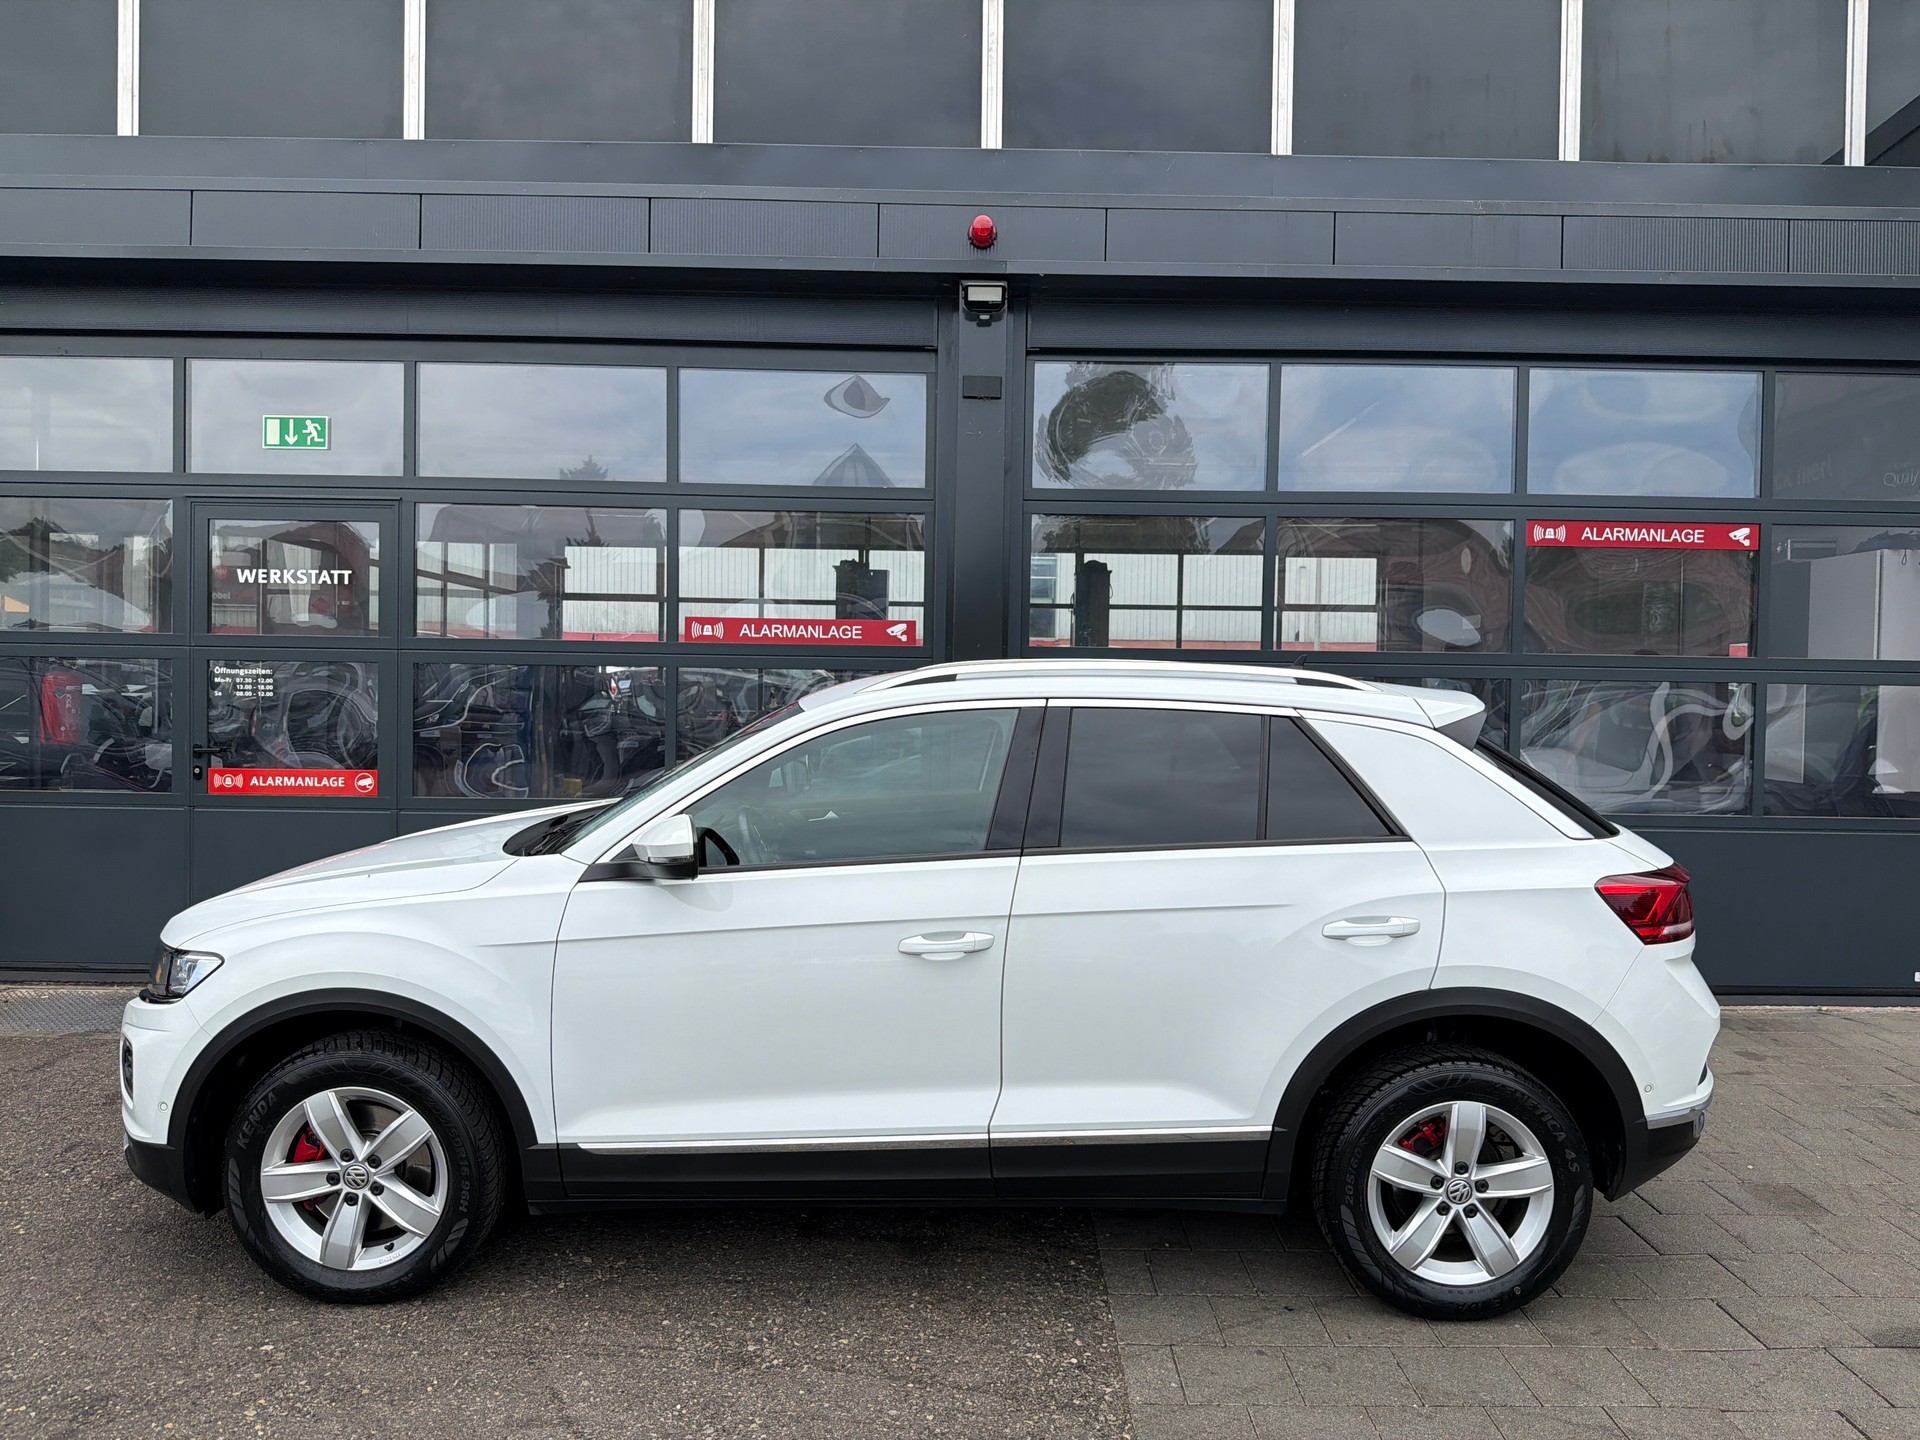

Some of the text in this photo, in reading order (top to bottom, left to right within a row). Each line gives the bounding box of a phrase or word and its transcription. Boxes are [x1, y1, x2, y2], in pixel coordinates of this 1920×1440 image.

[1581, 526, 1705, 543] ALARMANLAGE
[237, 568, 352, 585] WERKSTATT
[739, 623, 863, 639] ALARMANLAGE
[214, 666, 273, 676] Öffnungszeiten:
[250, 775, 345, 788] ALARMANLAGE
[237, 1091, 278, 1151] KENDA
[458, 1179, 471, 1213] 96H
